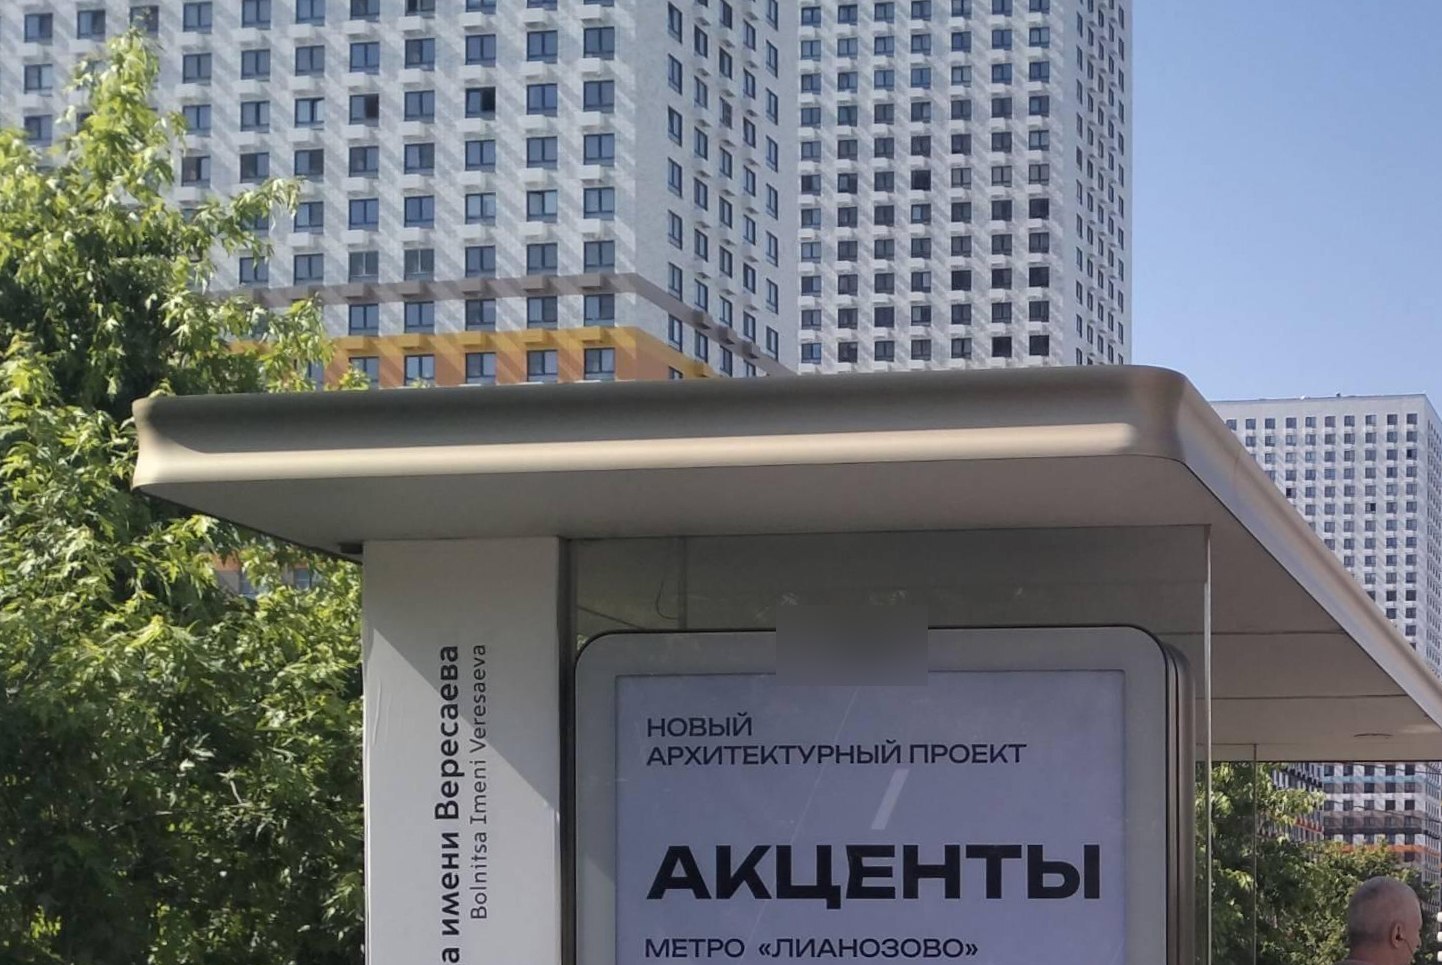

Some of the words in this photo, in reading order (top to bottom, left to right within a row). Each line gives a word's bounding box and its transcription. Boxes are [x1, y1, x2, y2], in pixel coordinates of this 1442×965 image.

[469, 643, 488, 753] Veresaeva
[646, 712, 753, 738] НОВЫЙ
[434, 645, 464, 821] Вересаева
[646, 739, 902, 767] АРХИТЕКТУРНЫЙ
[908, 743, 1028, 765] ПРОЕКТ
[469, 760, 488, 826] Imeni
[440, 831, 461, 936] имени
[469, 831, 488, 920] Bolnitsa
[645, 843, 1101, 910] АКЦЕНТЫ
[644, 937, 746, 959] МЕТРО
[757, 937, 979, 959] «ЛИАНОЗОВО»
